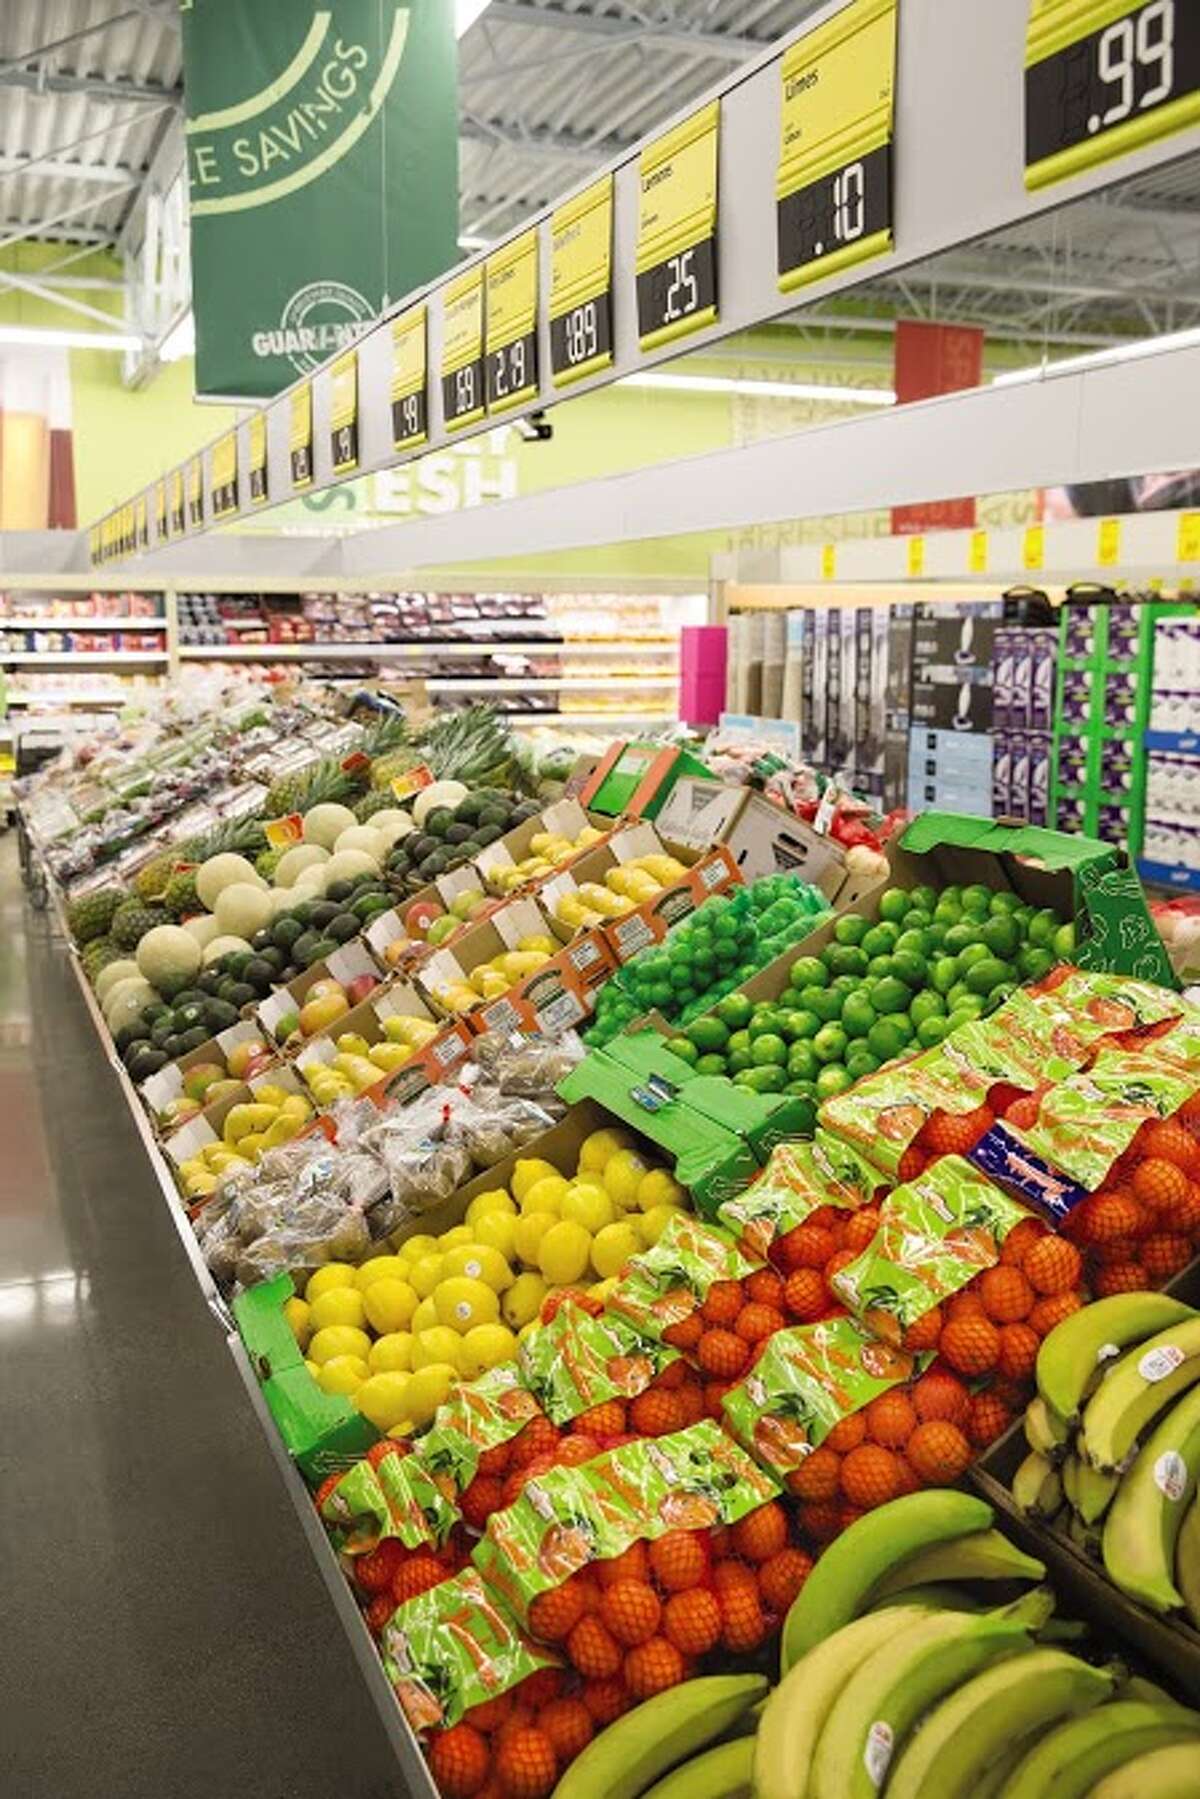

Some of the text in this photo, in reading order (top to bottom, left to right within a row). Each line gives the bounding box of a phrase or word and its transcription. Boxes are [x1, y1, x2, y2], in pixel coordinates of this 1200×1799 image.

[190, 39, 368, 186] E SAVINGS
[785, 68, 818, 102] Limes
[1087, 0, 1174, 133] .99
[814, 162, 864, 255] .10
